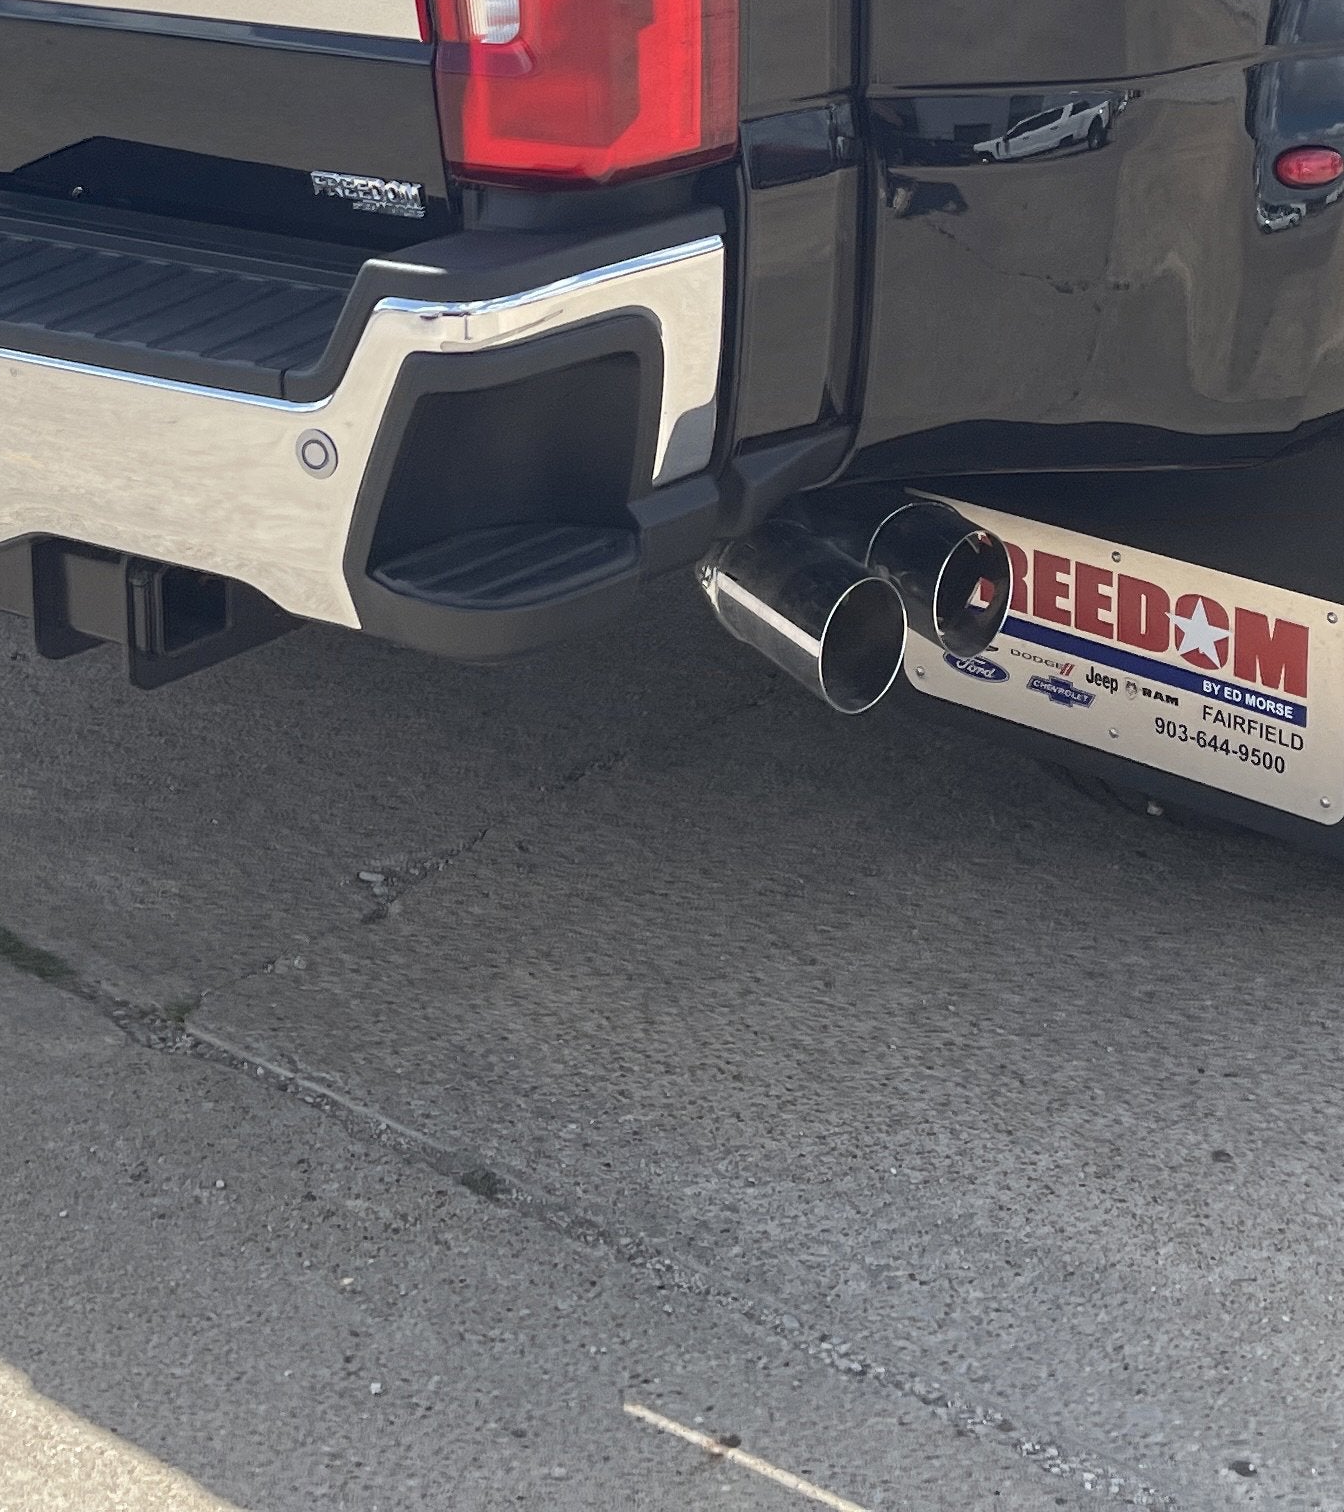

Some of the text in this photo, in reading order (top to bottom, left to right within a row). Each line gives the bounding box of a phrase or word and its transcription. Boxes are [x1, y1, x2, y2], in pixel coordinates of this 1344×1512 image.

[311, 170, 423, 209] FREEDOM
[1032, 678, 1090, 704] CHEVROLET
[1085, 665, 1119, 695] Jeep
[1141, 687, 1180, 707] RAM
[1203, 679, 1294, 720] BY ED MORSE
[1154, 716, 1286, 775] 903-644-9500
[1202, 704, 1305, 752] FAIRFIELD
